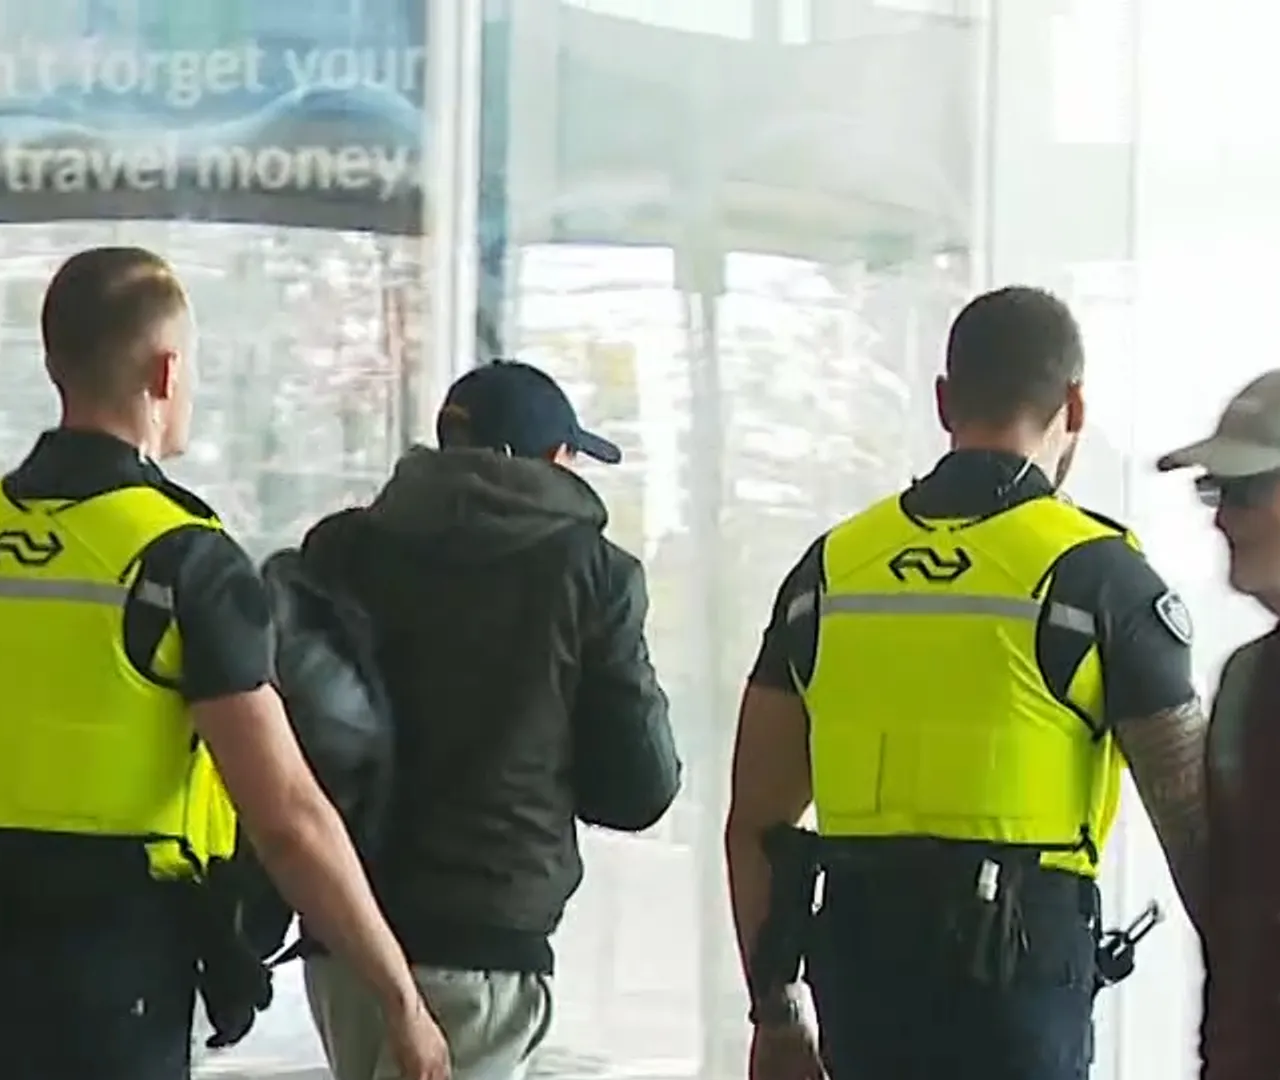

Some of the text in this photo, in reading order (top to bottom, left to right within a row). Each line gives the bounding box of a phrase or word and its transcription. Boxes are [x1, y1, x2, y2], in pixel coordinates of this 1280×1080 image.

[79, 38, 265, 106] forget
[283, 46, 423, 100] your
[2, 133, 179, 193] travel
